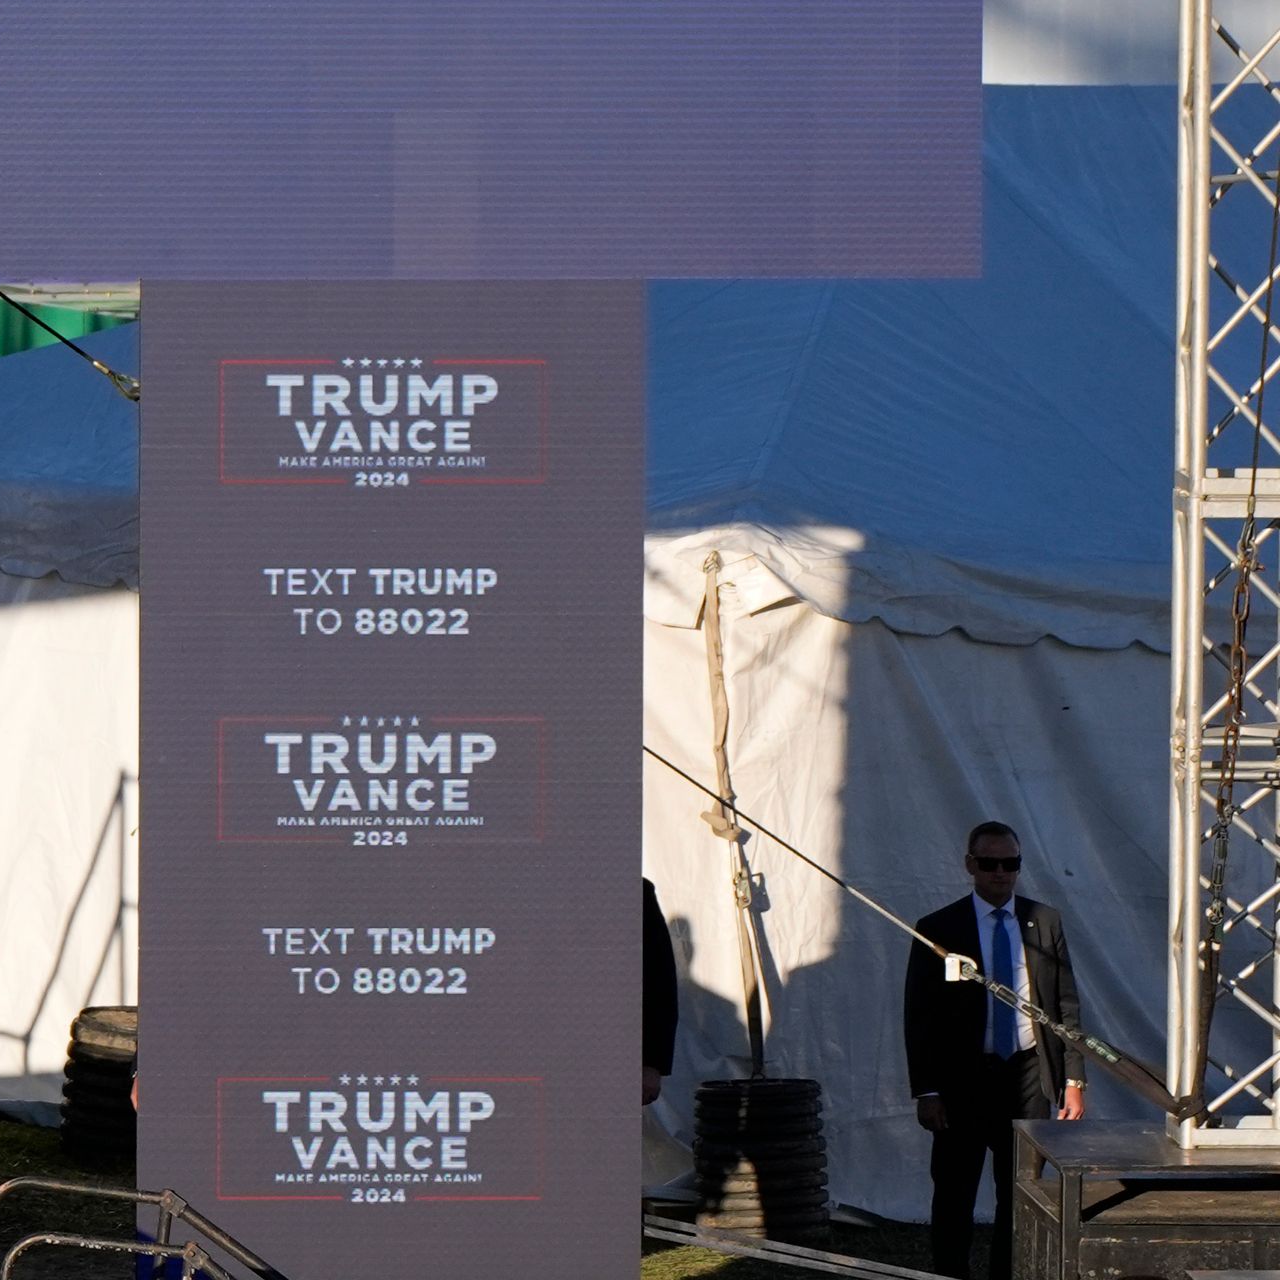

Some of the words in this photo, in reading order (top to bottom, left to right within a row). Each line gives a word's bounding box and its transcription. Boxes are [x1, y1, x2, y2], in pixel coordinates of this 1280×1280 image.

[266, 374, 499, 417] TRUMP
[295, 419, 471, 453] VANCE
[279, 455, 318, 467] MAKE
[322, 455, 384, 467] AMERICA
[388, 455, 433, 467] GREAT
[437, 455, 486, 467] AGAIN!
[355, 471, 410, 488] 2024
[264, 568, 357, 596] TEXT
[369, 568, 498, 596] TRUMP
[293, 608, 342, 635] TO
[354, 608, 470, 635] 88022
[265, 733, 497, 774] TRUMP
[293, 778, 470, 812] VANCE
[277, 816, 315, 826] MAKE
[319, 816, 382, 826] AMERICA
[386, 816, 430, 826] GREAT
[435, 816, 485, 826] AGAIN!
[353, 830, 408, 846] 2024
[262, 927, 355, 955] TEXT
[367, 927, 496, 955] TRUMP
[291, 967, 341, 995] TO
[353, 967, 468, 995] 88022
[263, 1091, 496, 1133] TRUMP
[291, 1136, 468, 1169] VANCE
[275, 1173, 314, 1184] MAKE
[319, 1173, 380, 1184] AMERICA
[384, 1173, 429, 1184] GREAT
[434, 1173, 483, 1184] AGAIN!
[351, 1188, 407, 1204] 2024
